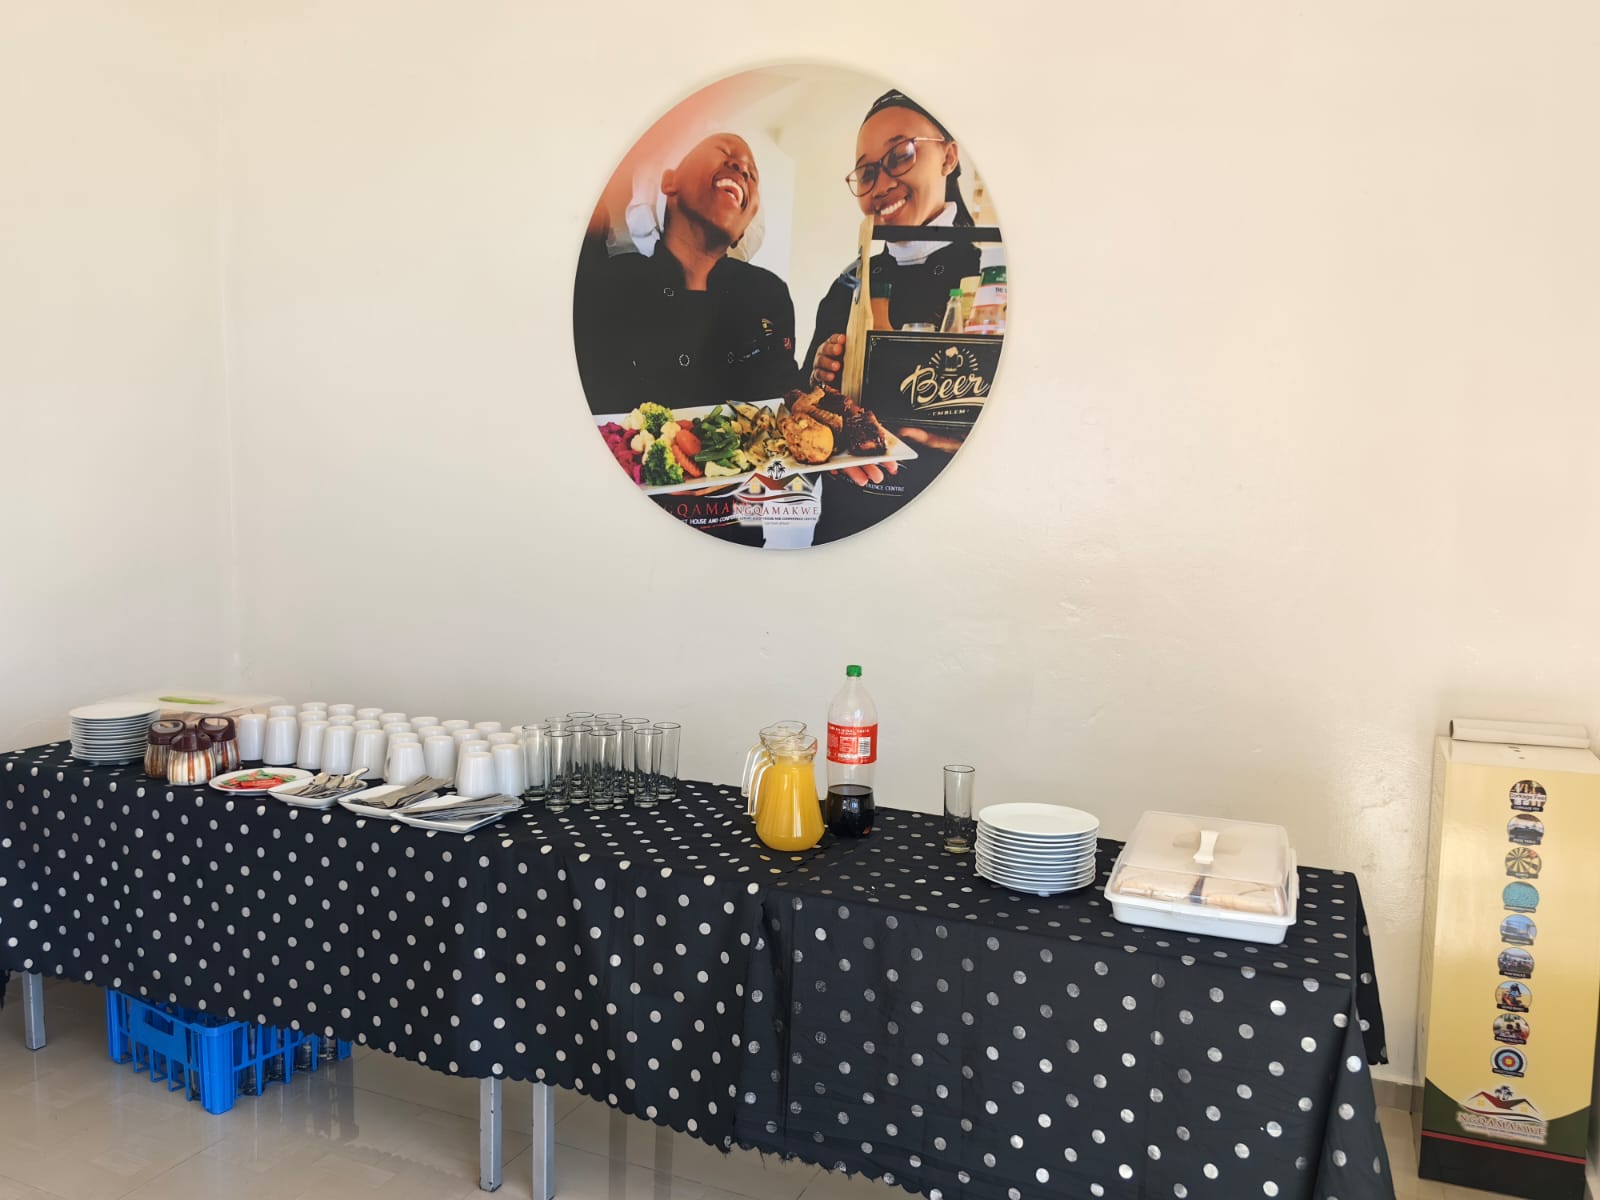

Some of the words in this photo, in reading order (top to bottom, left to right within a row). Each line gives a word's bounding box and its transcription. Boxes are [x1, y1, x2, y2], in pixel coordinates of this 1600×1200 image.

[900, 364, 991, 407] Beer
[885, 484, 904, 492] CENTRE
[735, 505, 817, 517] NGQAMAKWE
